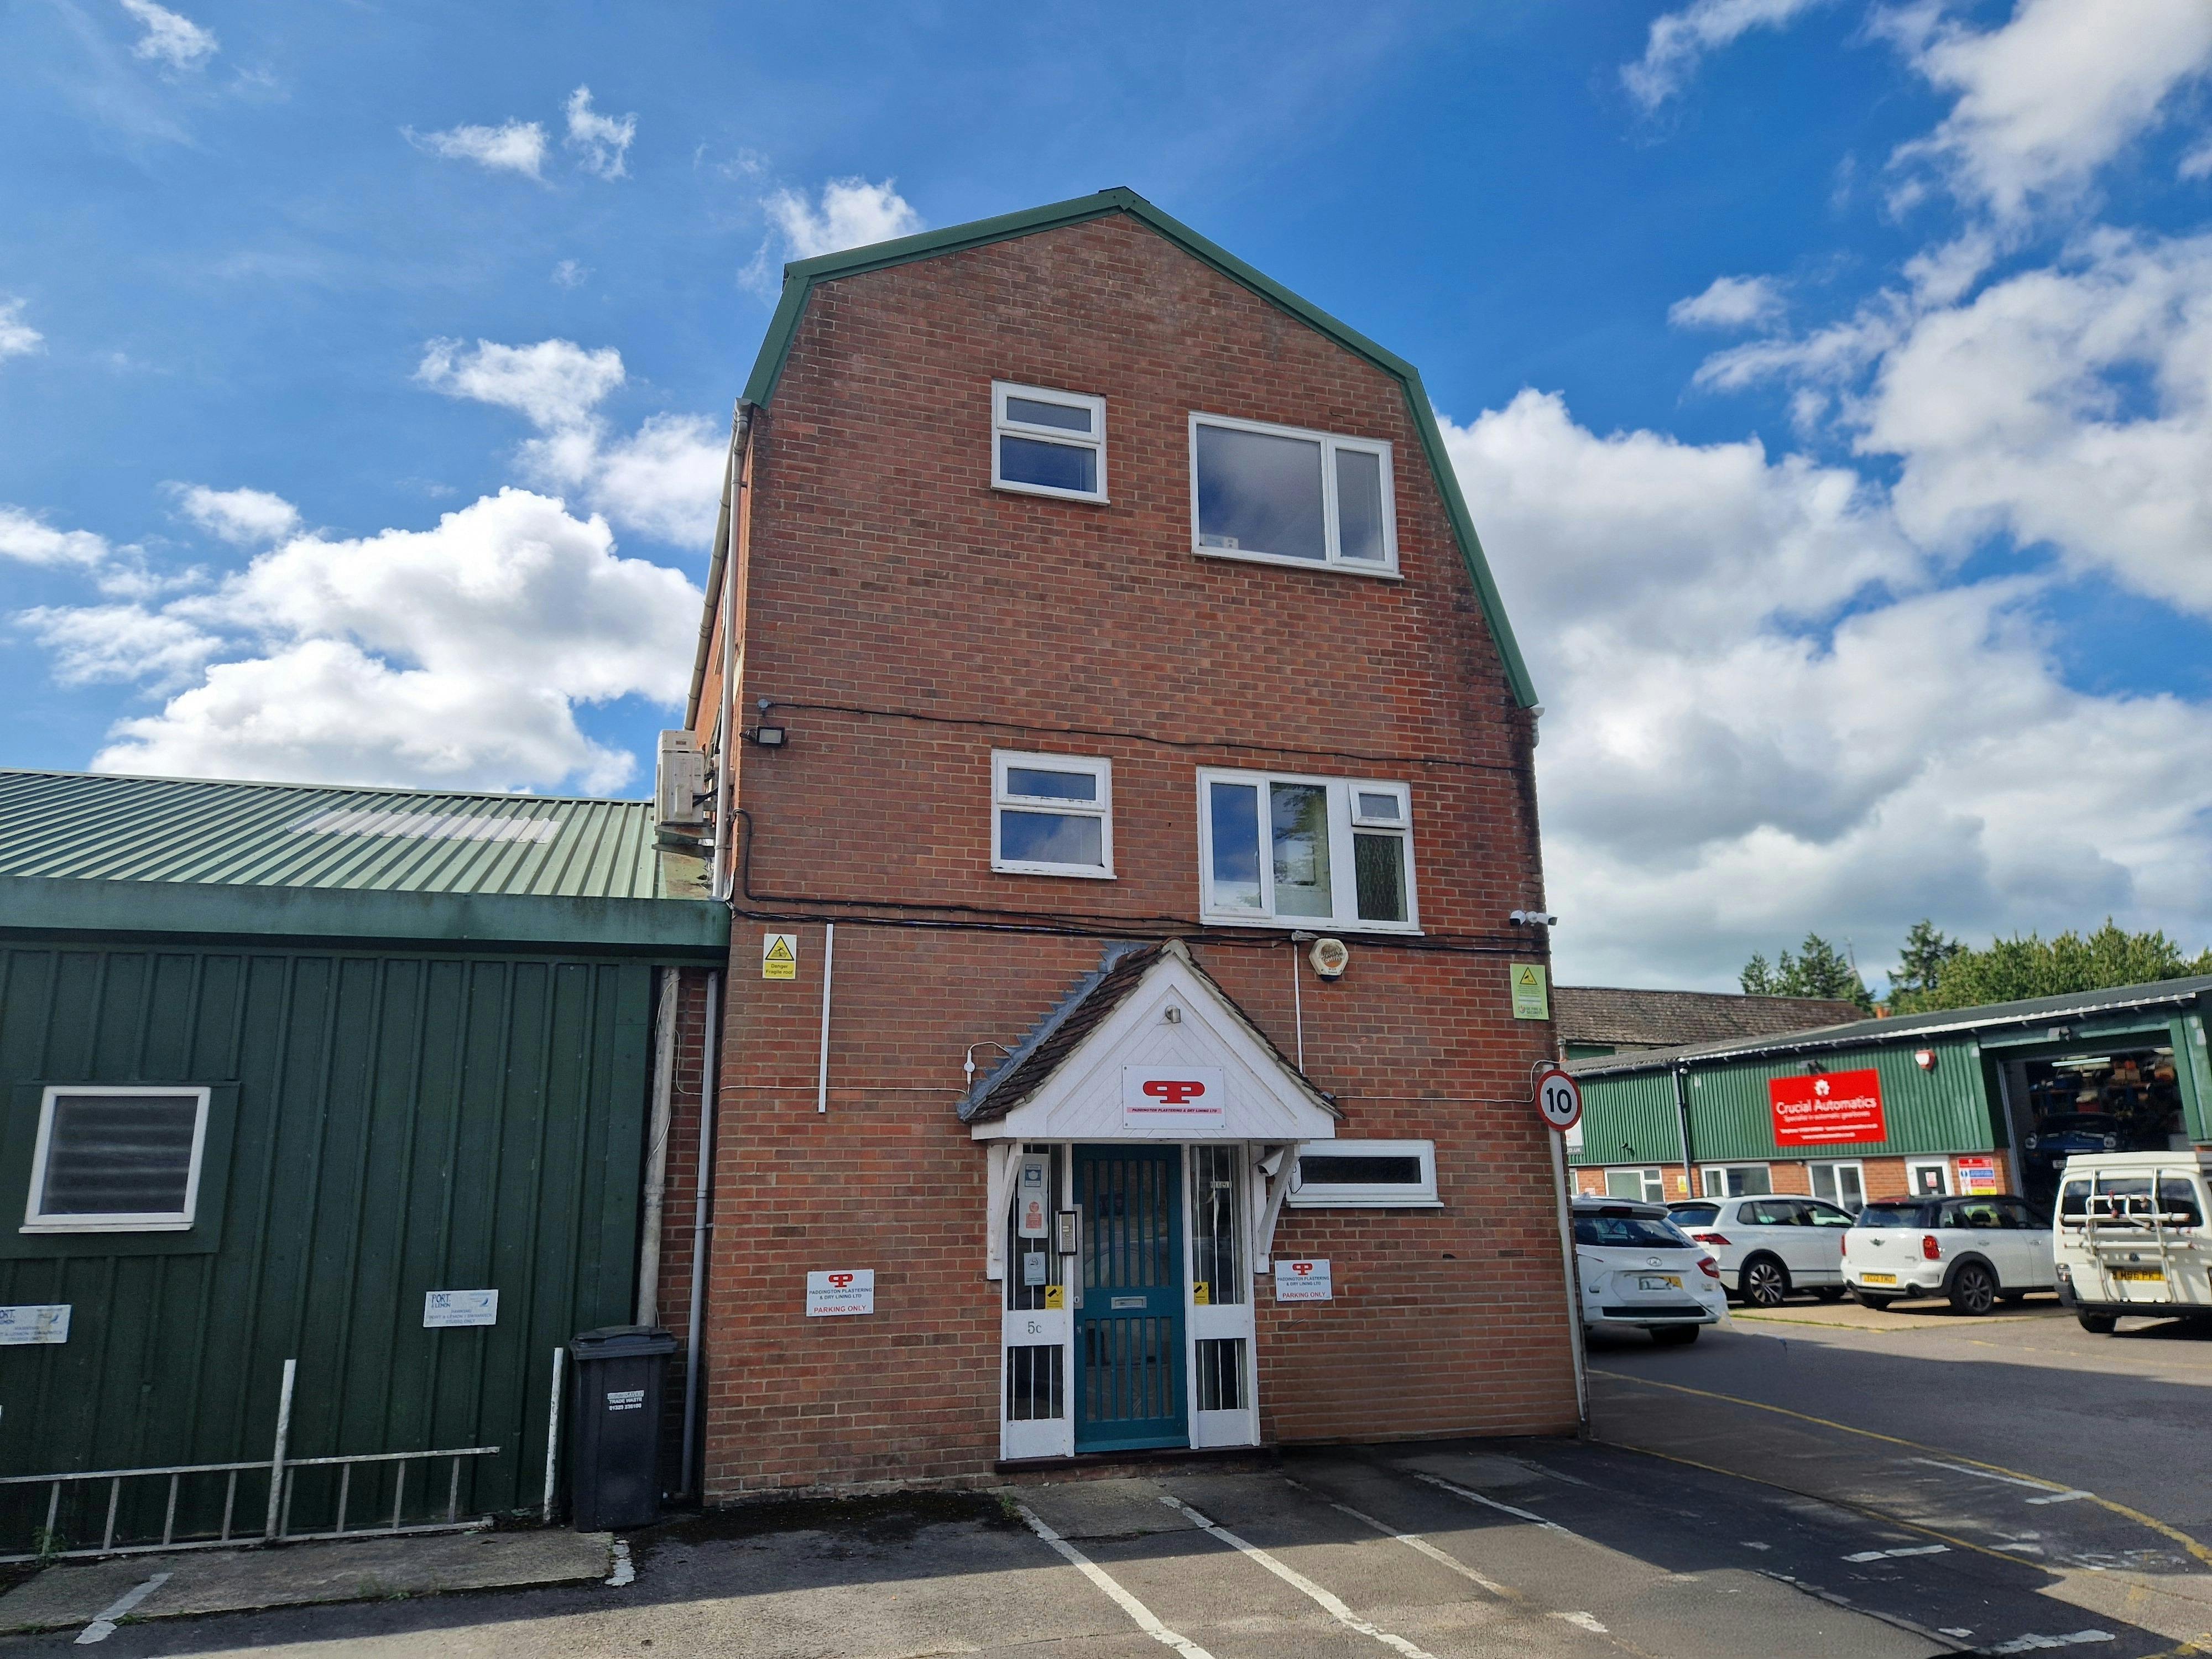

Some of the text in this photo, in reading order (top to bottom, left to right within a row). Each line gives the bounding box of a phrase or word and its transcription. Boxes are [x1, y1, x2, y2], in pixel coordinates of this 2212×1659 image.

[1547, 1088, 1572, 1113] 10
[1776, 1095, 1877, 1115] Crucial Automatics
